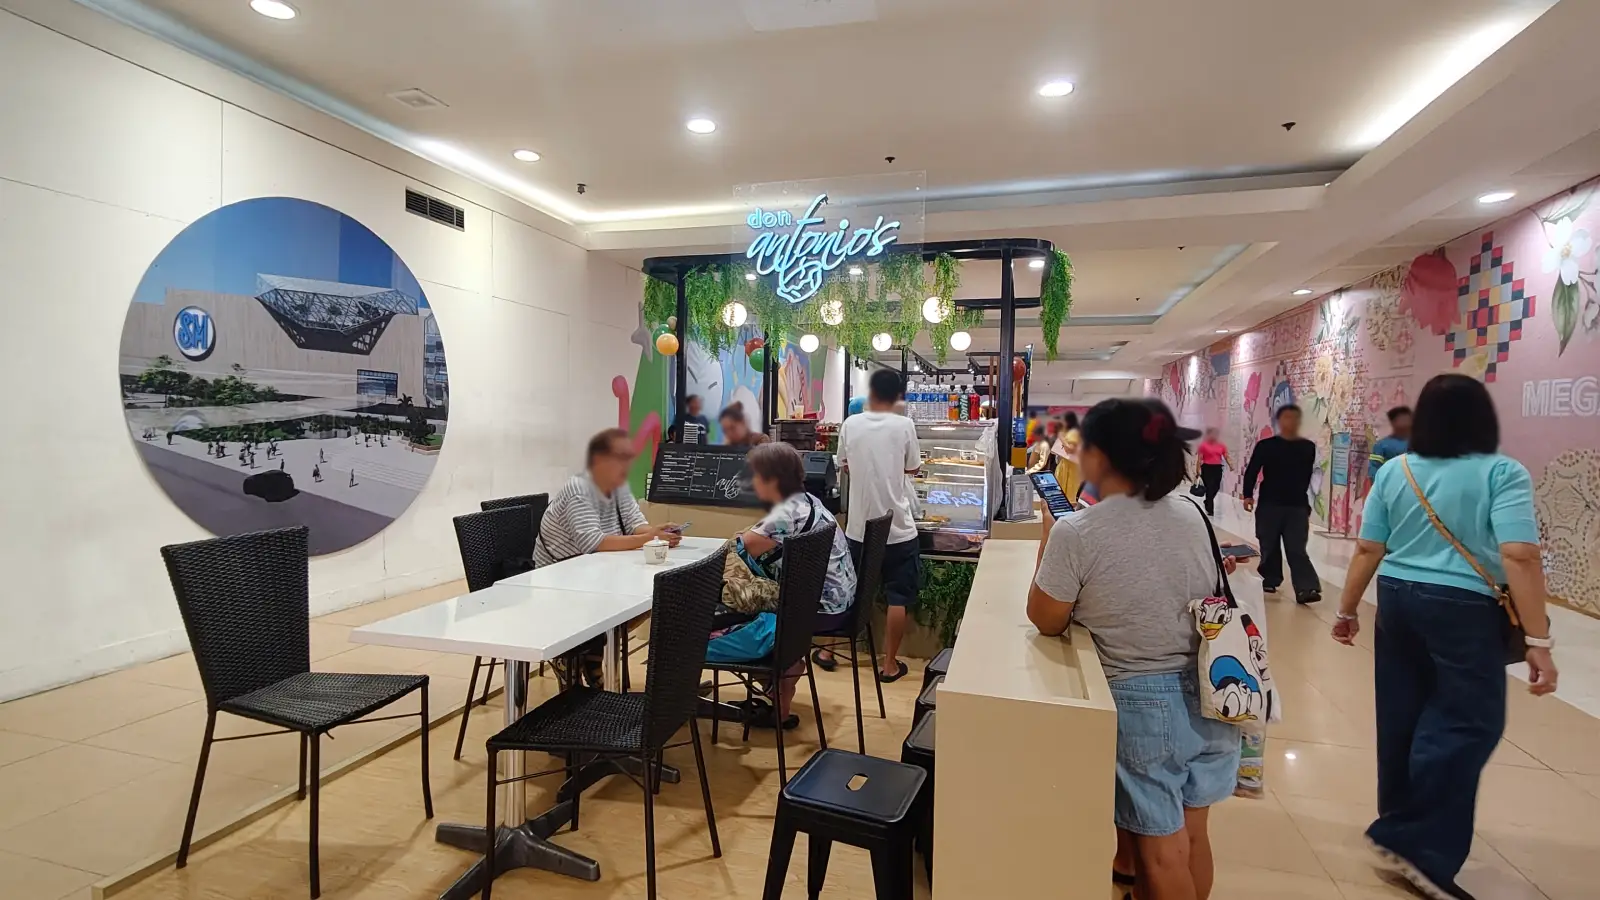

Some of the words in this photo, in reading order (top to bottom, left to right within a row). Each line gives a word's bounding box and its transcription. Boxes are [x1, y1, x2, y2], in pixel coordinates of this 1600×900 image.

[746, 207, 792, 230] don
[746, 193, 901, 276] antonio's
[178, 310, 209, 350] SM
[960, 393, 969, 420] Sprite
[1522, 375, 1600, 418] MEG
